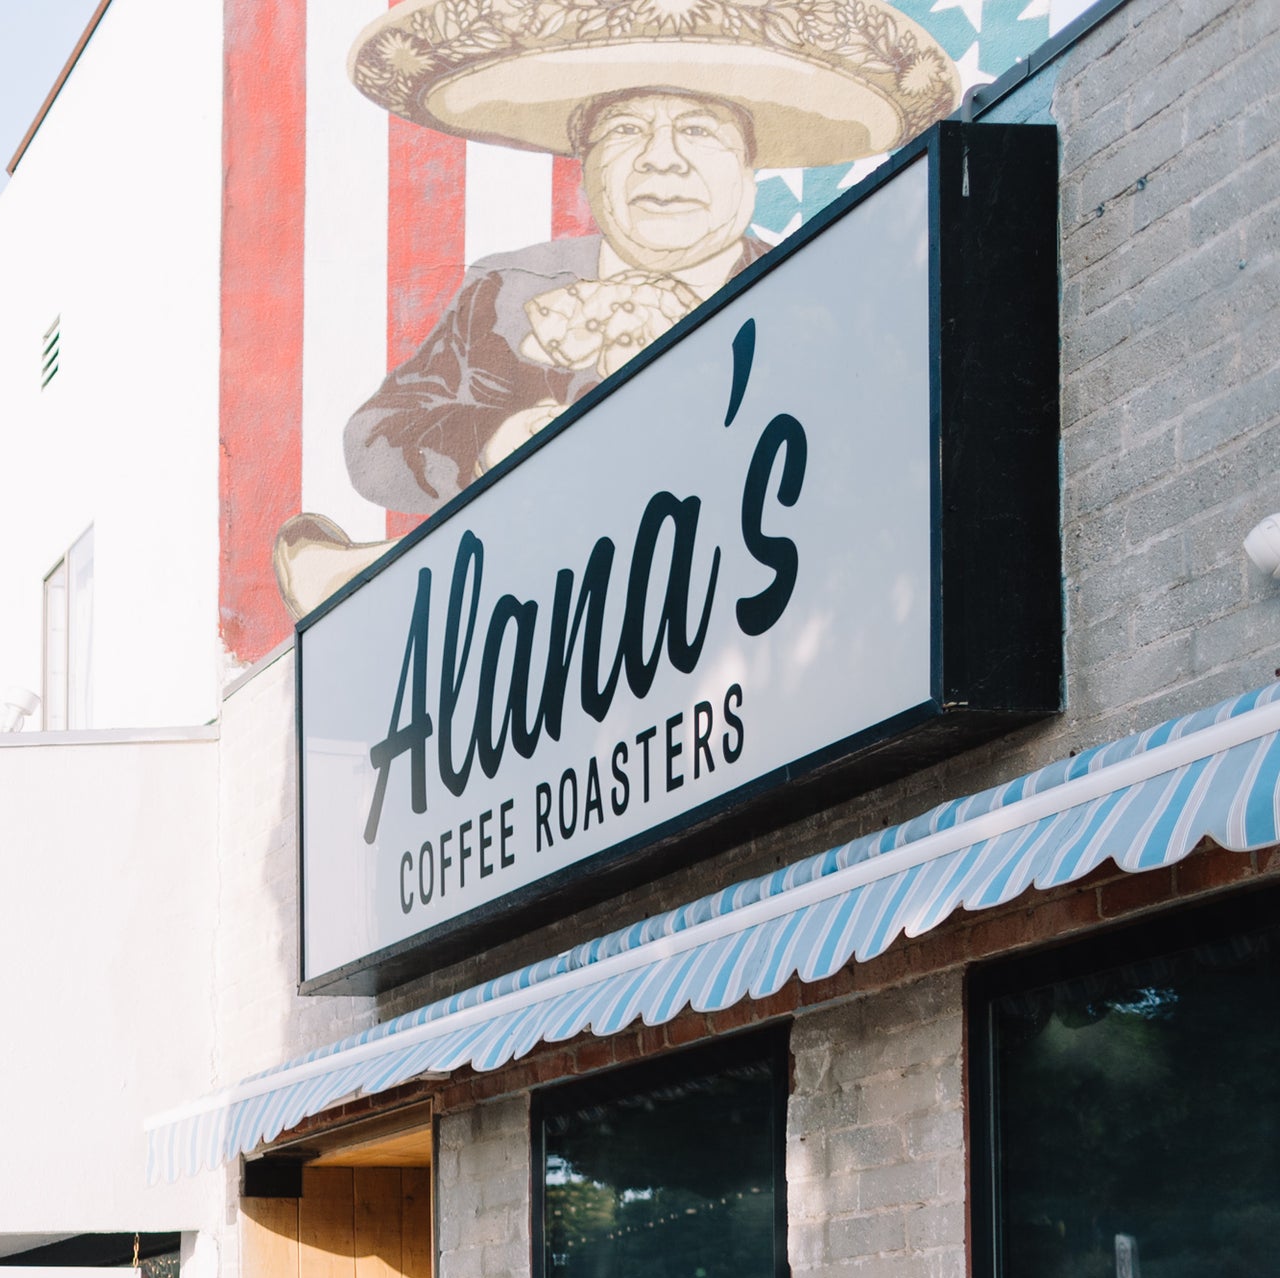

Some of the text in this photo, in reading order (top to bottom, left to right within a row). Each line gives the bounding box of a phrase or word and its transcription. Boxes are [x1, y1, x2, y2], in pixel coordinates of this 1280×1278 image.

[363, 318, 808, 845] Alana's
[400, 683, 744, 914] COFFEE ROASTERS
